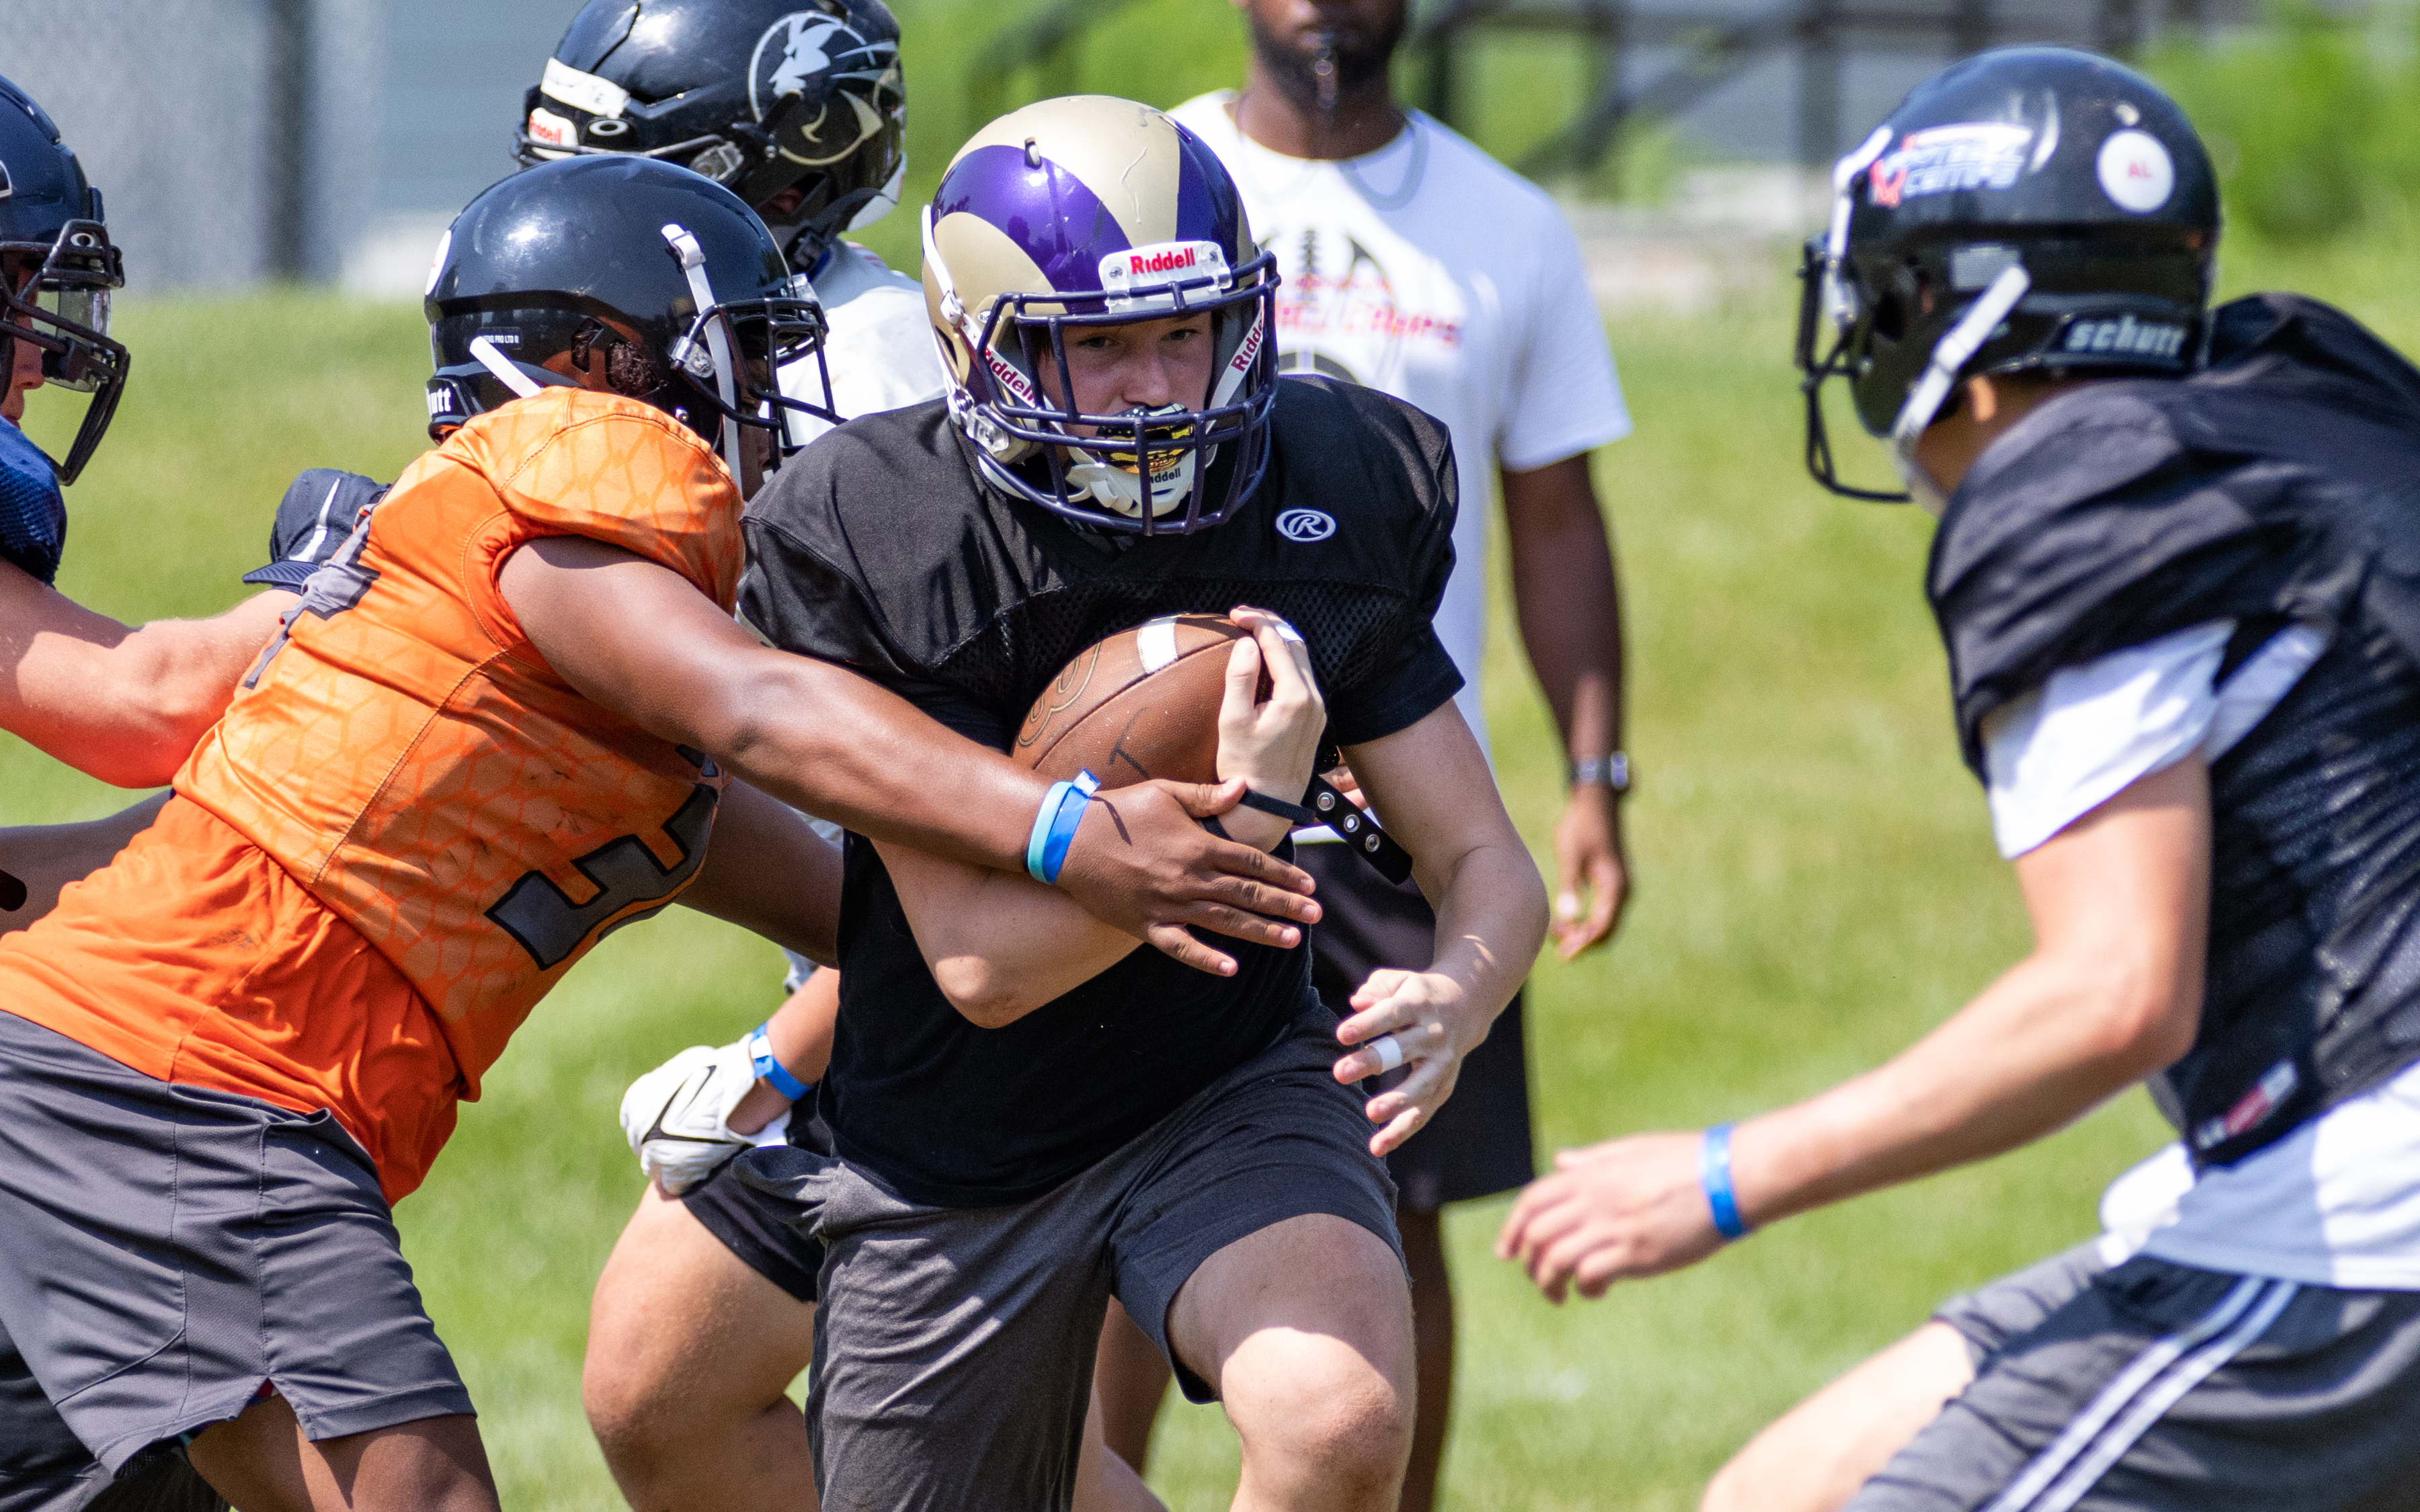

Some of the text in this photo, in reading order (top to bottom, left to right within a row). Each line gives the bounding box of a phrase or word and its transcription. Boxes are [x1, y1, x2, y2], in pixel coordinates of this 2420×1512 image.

[1130, 247, 1196, 275] Riddell
[1231, 317, 1264, 372] Ridde
[985, 347, 1035, 401] iddel
[1150, 467, 1181, 484] iddell
[483, 782, 719, 972] 3
